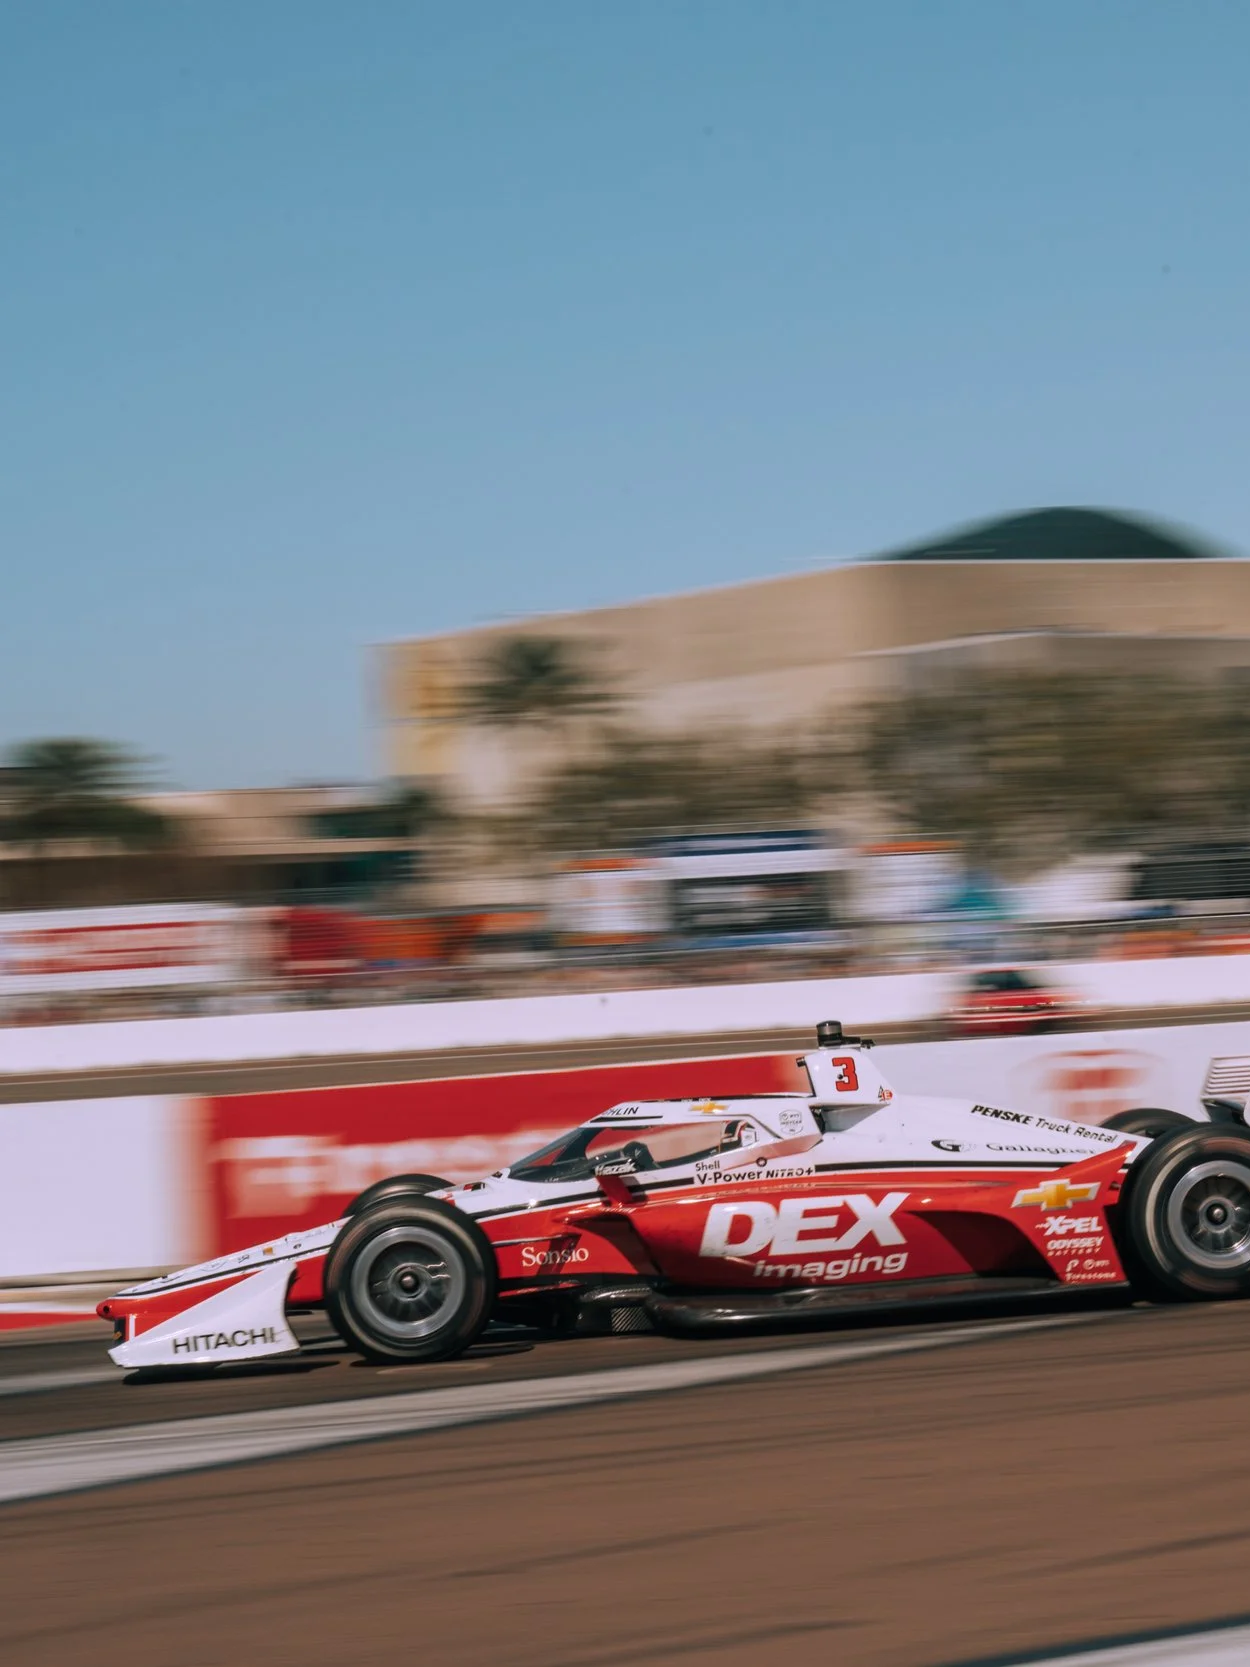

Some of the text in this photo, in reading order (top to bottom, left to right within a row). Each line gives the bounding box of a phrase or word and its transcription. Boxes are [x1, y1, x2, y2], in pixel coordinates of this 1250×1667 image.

[831, 1056, 859, 1092] 3
[971, 1104, 1118, 1144] PENSKE Truck Rental
[986, 1142, 1096, 1155] Gallagher
[695, 1160, 721, 1172] Shell
[696, 1170, 763, 1185] V-Power
[698, 1192, 911, 1258] DEX
[1043, 1215, 1104, 1237] XPEL
[521, 1242, 589, 1267] Sonsio
[1046, 1236, 1105, 1250] ODYSSEY
[753, 1252, 909, 1280] imaging
[172, 1326, 275, 1354] HITACHI
